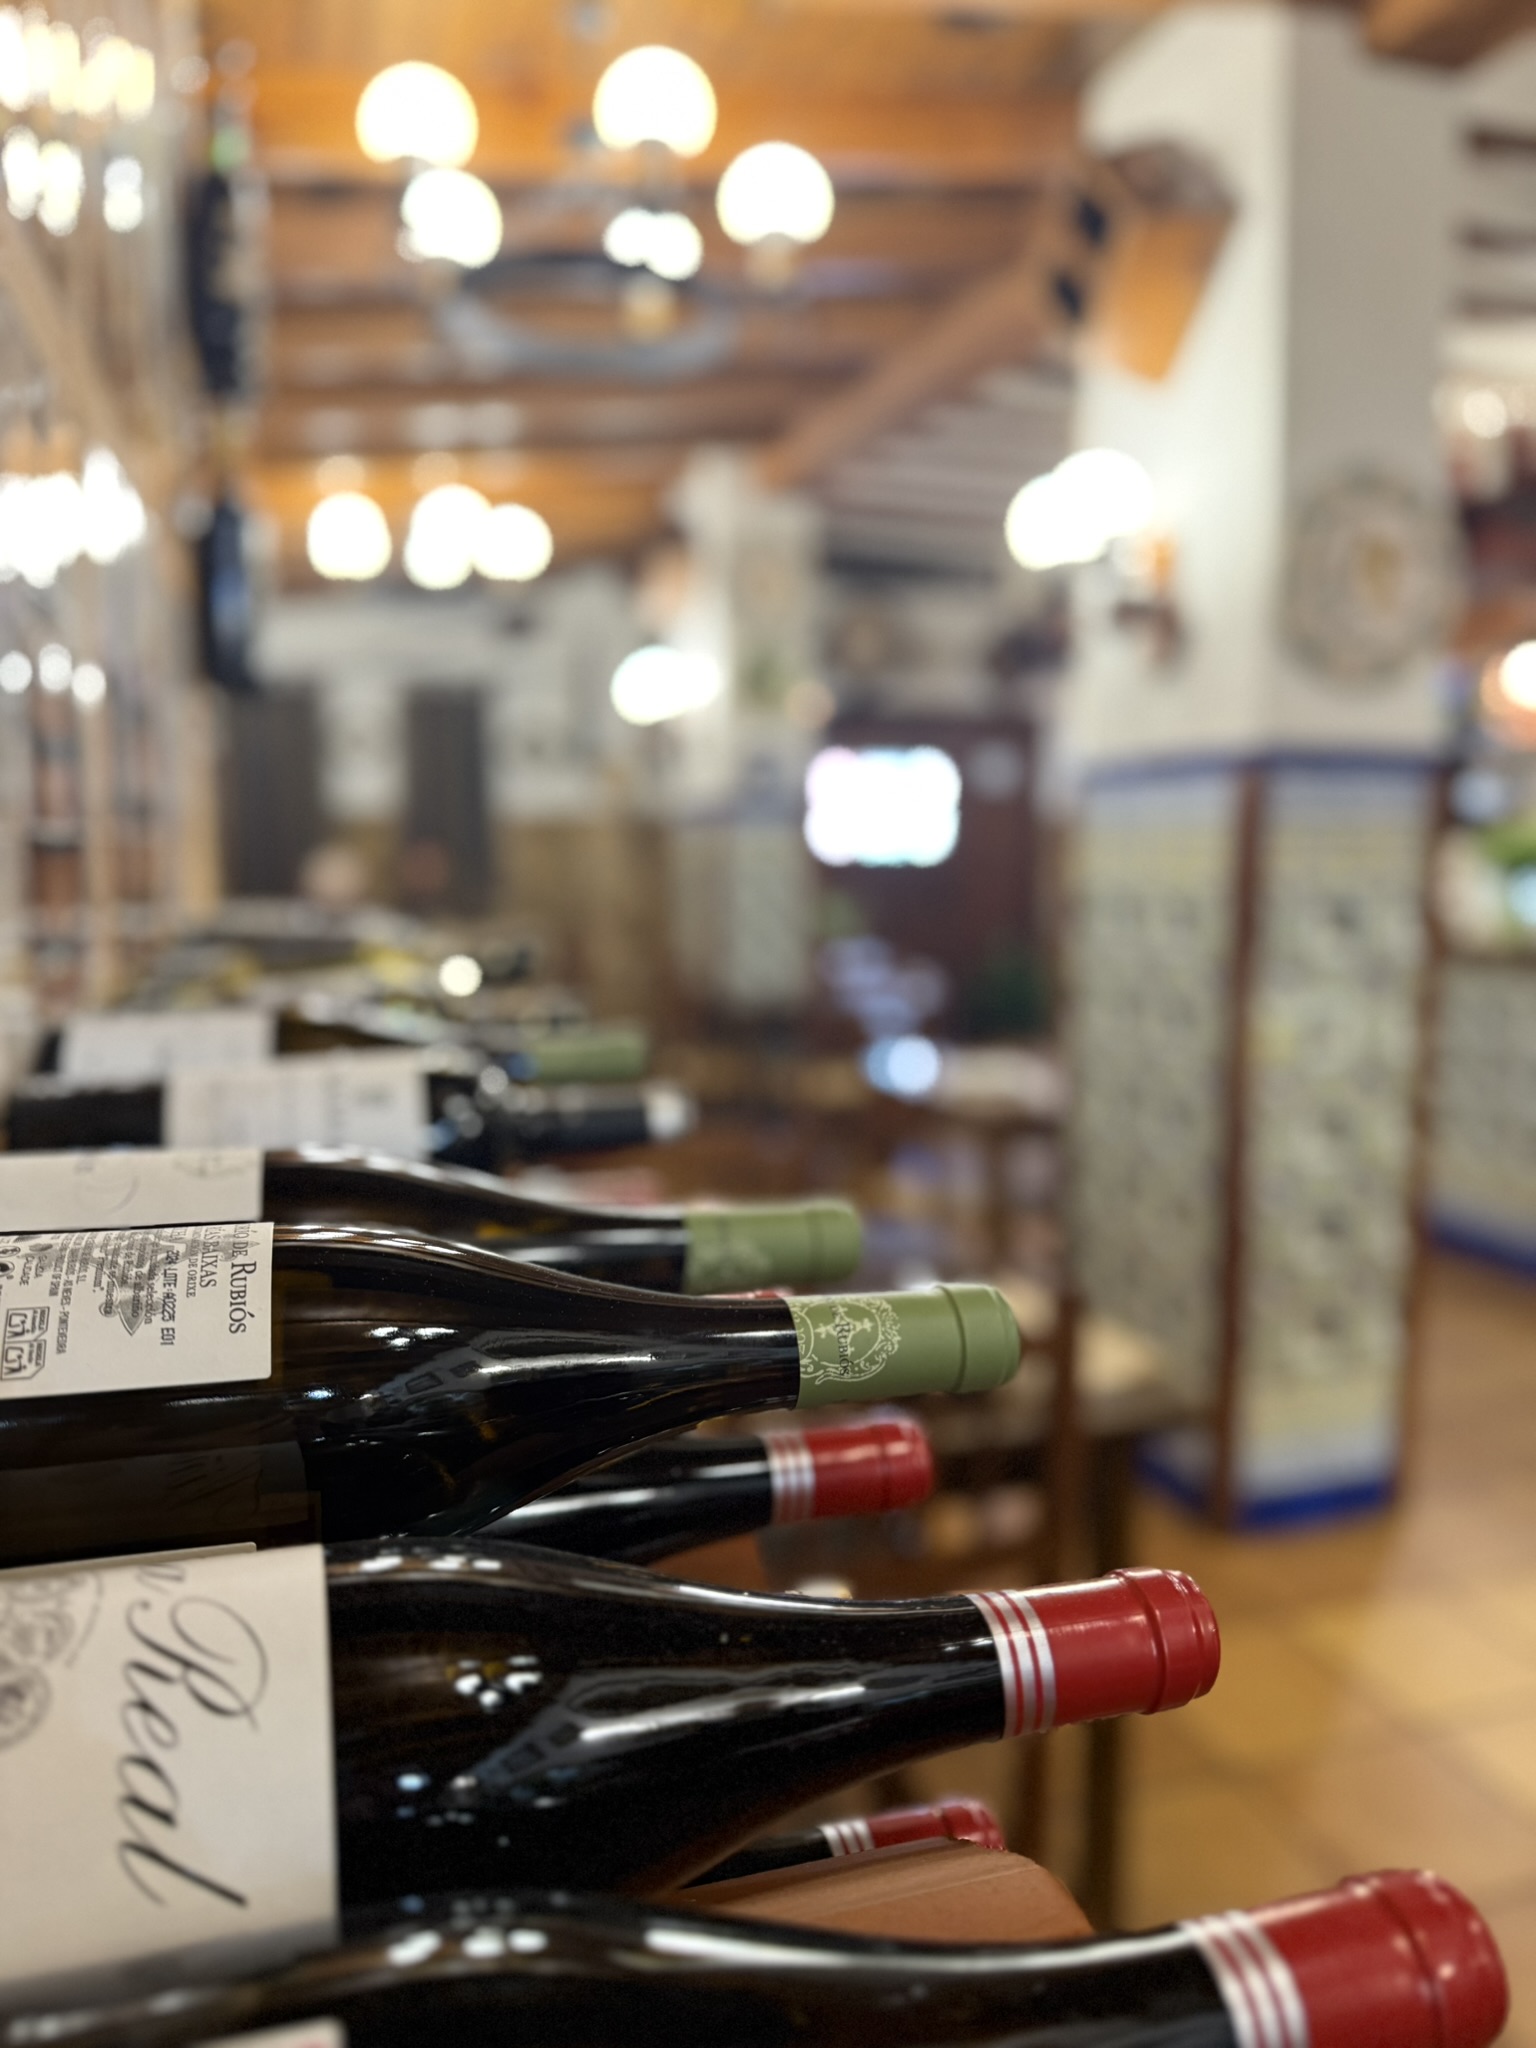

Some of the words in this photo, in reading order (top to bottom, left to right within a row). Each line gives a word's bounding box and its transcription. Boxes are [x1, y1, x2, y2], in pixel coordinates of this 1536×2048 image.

[187, 1258, 198, 1269] DE
[199, 1241, 222, 1288] BAIXAS
[231, 1241, 249, 1257] DE
[104, 1280, 115, 1315] muestra
[131, 1281, 145, 1318] albariño
[144, 1282, 158, 1325] selección
[186, 1269, 197, 1299] ORIXE
[229, 1261, 257, 1335] RUBIÓS
[833, 1322, 855, 1377] RUBIÓS
[116, 1596, 269, 1909] Real
